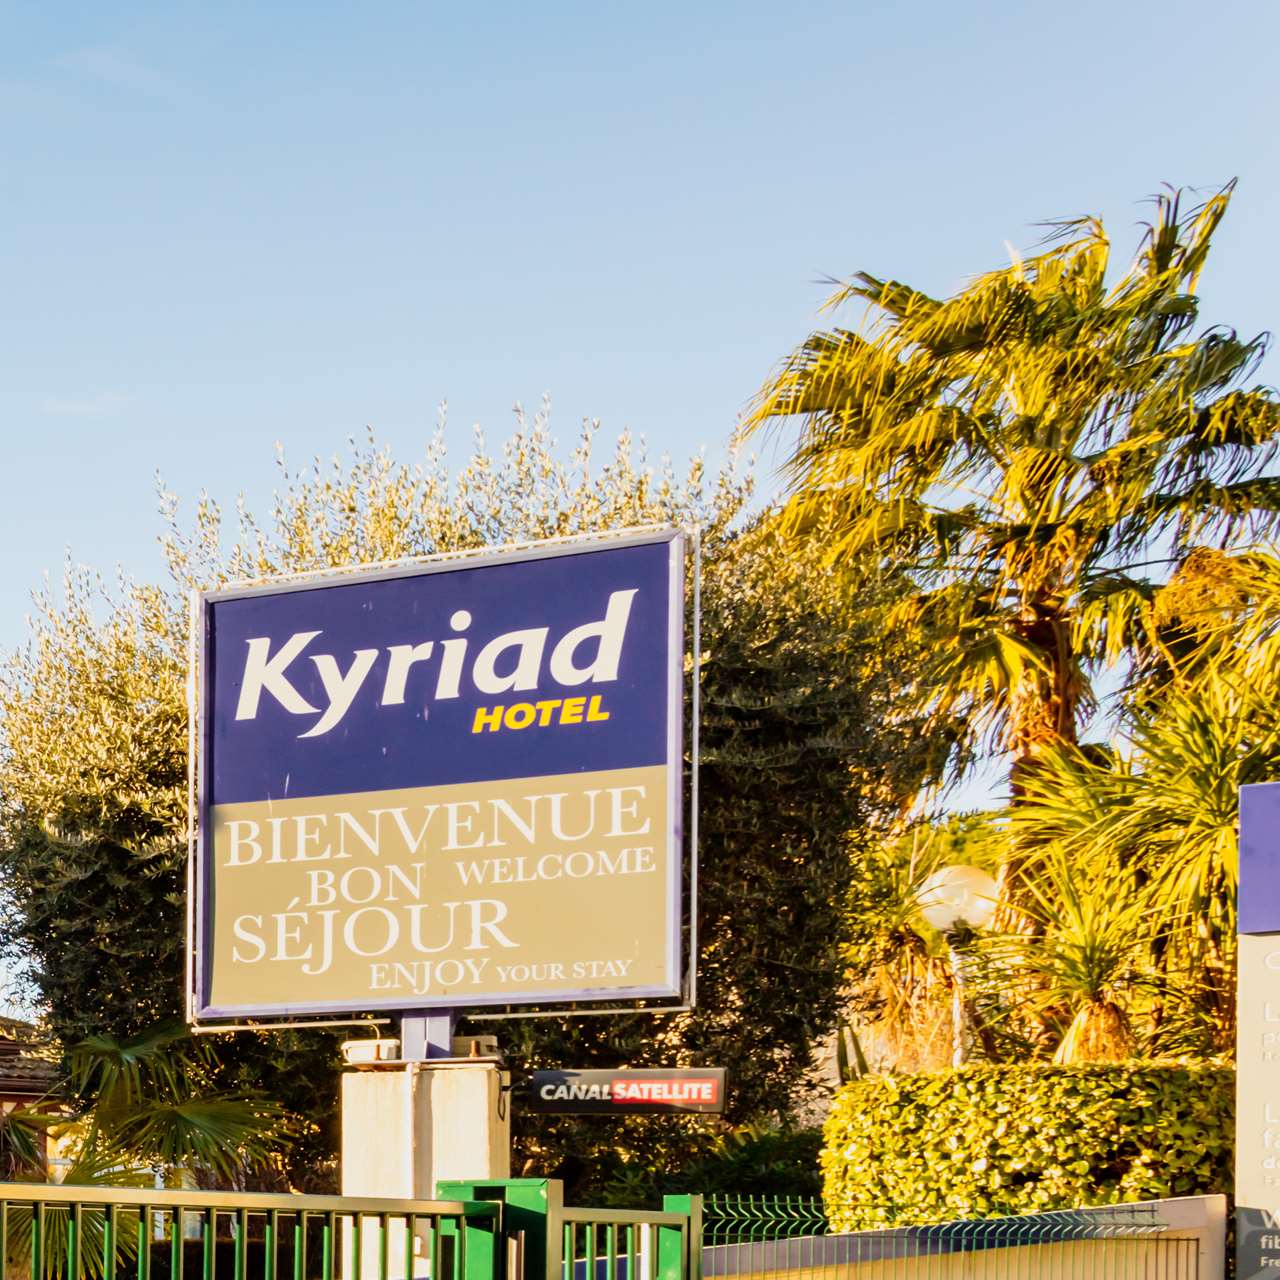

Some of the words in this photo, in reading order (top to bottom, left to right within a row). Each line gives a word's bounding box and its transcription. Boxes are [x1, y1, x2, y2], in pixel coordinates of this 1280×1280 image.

[235, 588, 639, 739] Kyriad
[471, 695, 610, 734] HOTEL
[223, 785, 651, 867] BIENVENUE
[306, 862, 424, 907] BON
[456, 846, 657, 885] WELCOME
[232, 897, 520, 975] SÉJOUR
[369, 957, 490, 995] ENJOY
[496, 962, 567, 983] YOUR
[573, 958, 633, 980] STAY
